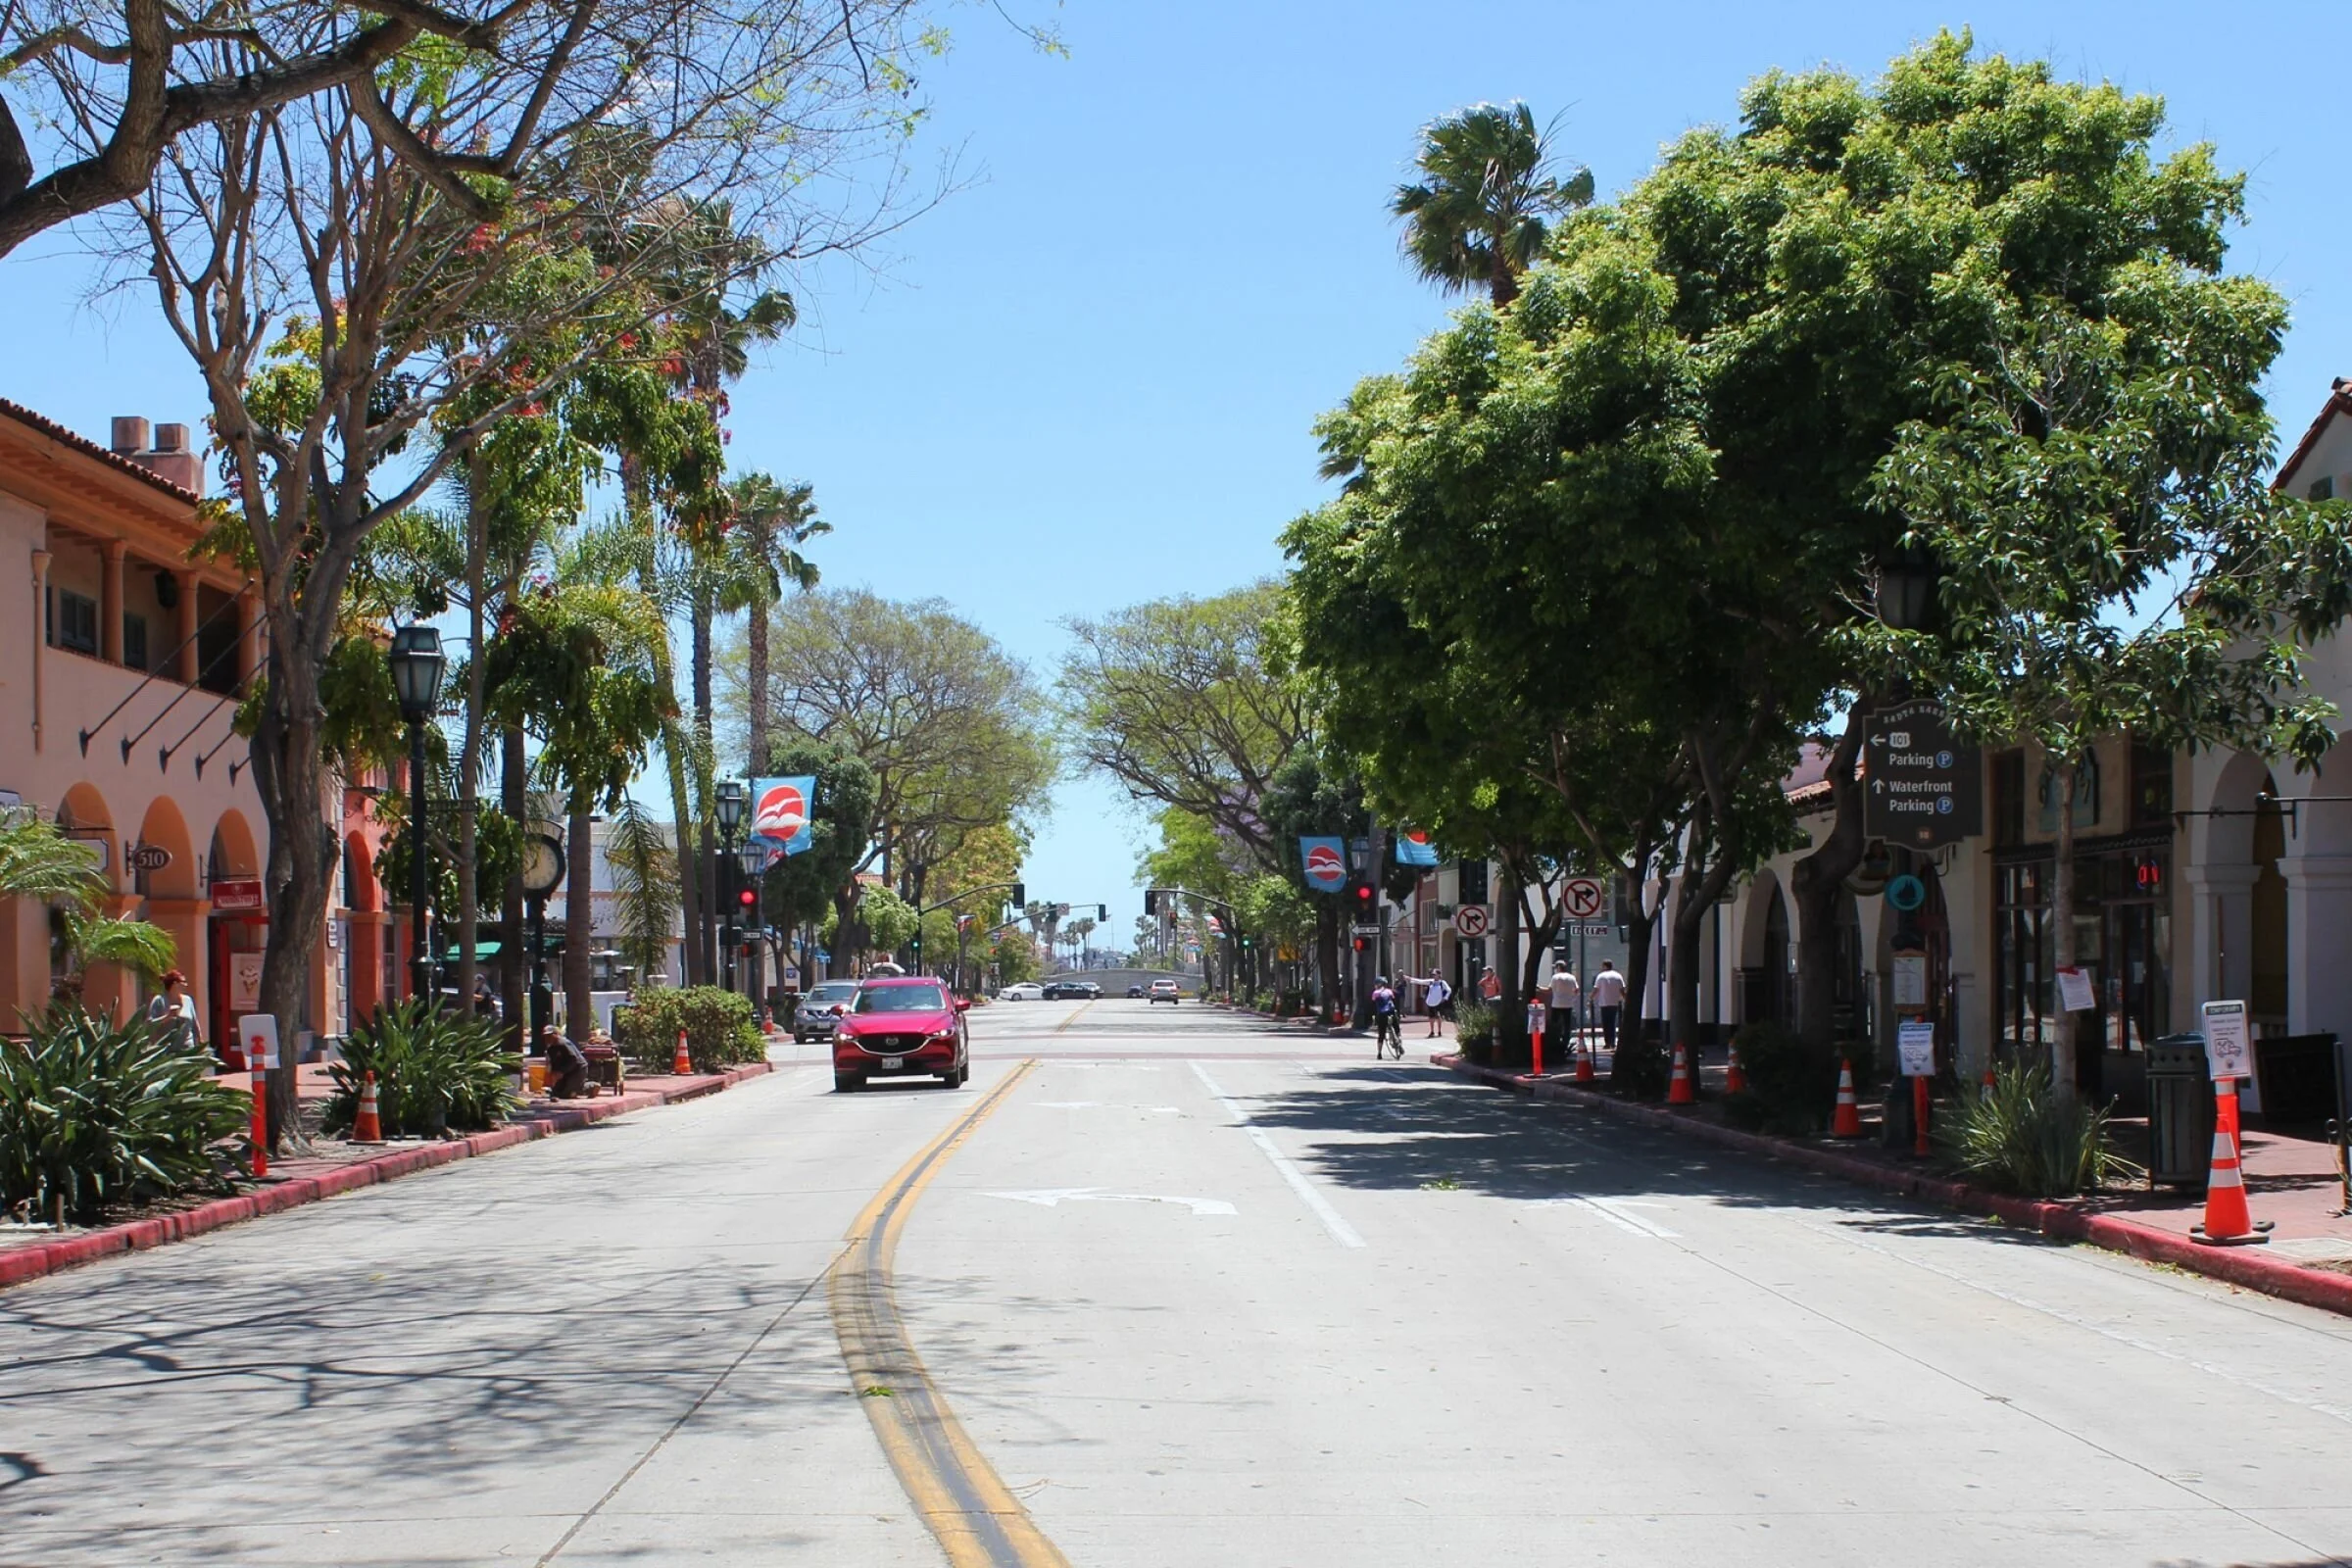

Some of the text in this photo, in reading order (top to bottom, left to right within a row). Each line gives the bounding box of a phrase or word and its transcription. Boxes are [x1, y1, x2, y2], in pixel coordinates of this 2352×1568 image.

[1891, 735, 1909, 746] 101
[1889, 753, 1935, 769] Parking
[1889, 780, 1953, 793] Waterfront
[1889, 799, 1935, 815] Parking
[137, 851, 165, 867] 510
